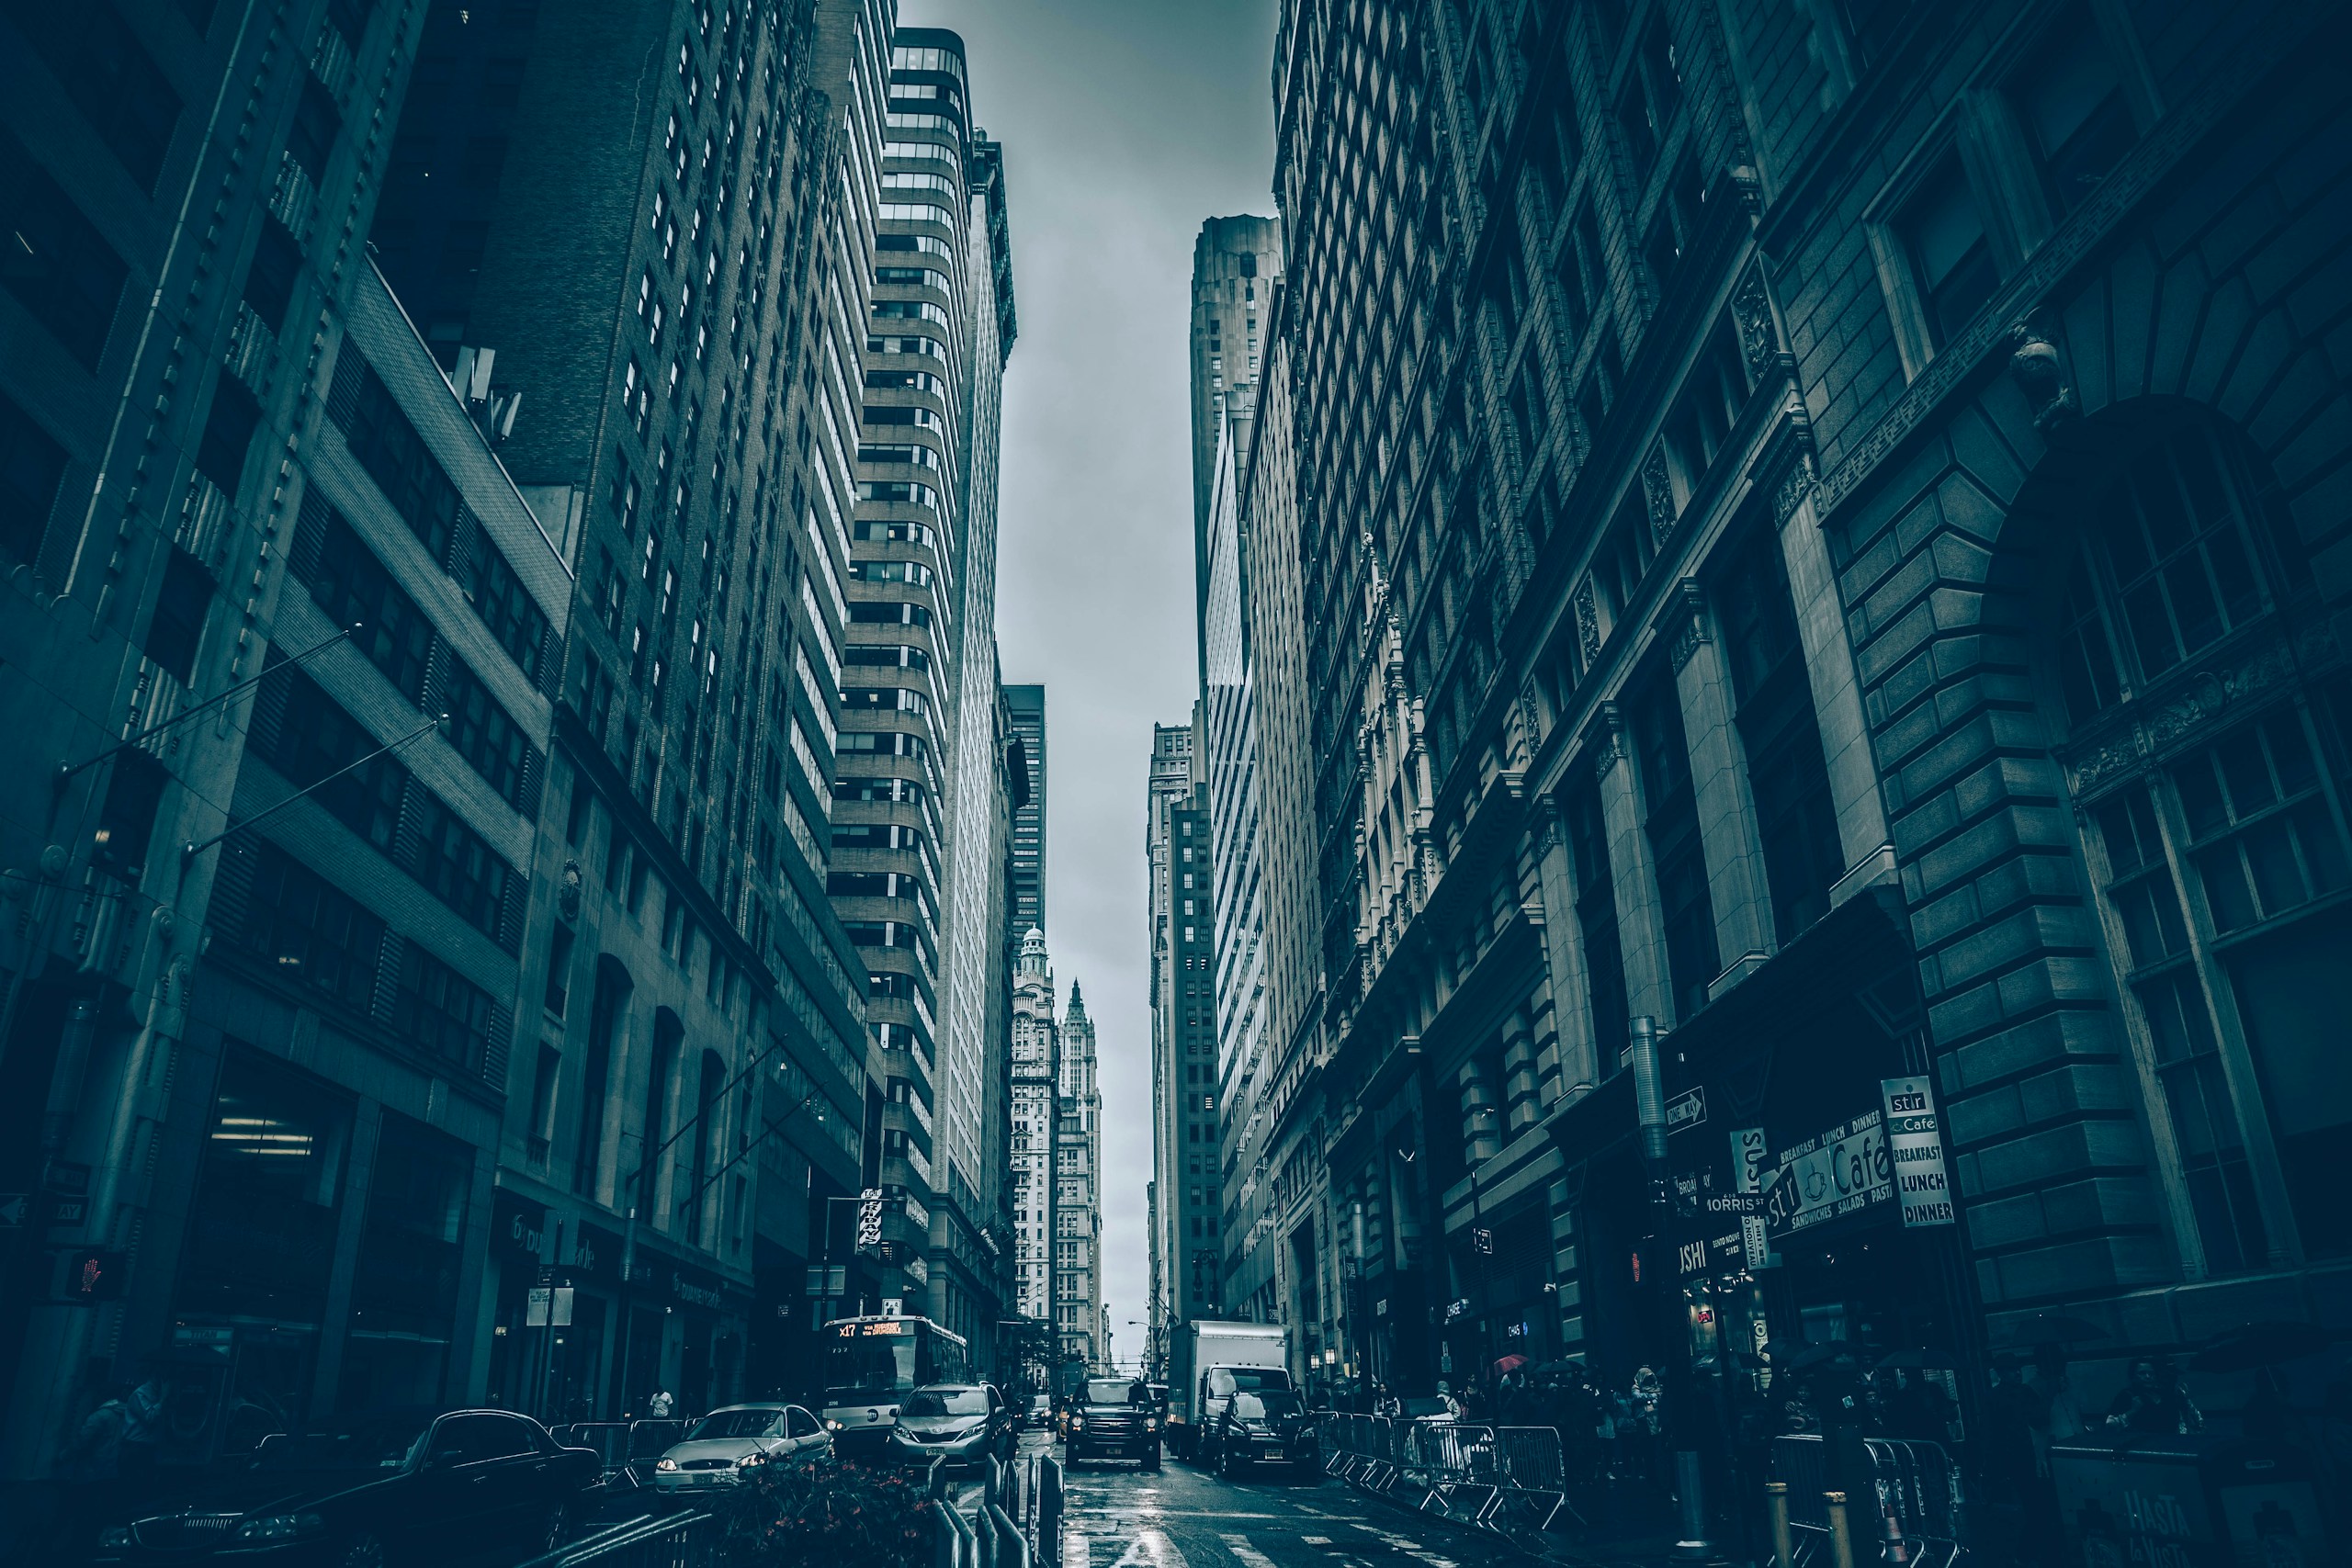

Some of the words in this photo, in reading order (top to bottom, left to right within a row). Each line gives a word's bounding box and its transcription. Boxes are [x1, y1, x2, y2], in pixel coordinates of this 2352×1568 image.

[1669, 1108, 1680, 1123] ONE
[1685, 1100, 1697, 1116] WAY
[1904, 1118, 1935, 1131] Café
[1781, 1139, 1815, 1163] BREAKFAST
[1822, 1126, 1845, 1145] LUNCH
[1852, 1110, 1881, 1134] DINNER
[1832, 1134, 1891, 1196] Café
[1894, 1145, 1940, 1163] BREAKFAST
[1901, 1173, 1945, 1192] LUNCH
[1792, 1205, 1833, 1229] SANDWICHES
[1838, 1193, 1865, 1215] SALADS
[1905, 1201, 1953, 1224] DINNER
[1746, 1227, 1756, 1267] NOUVEAU
[1447, 1302, 1461, 1317] CHASE
[191, 1329, 217, 1338] TITAN
[2124, 1490, 2190, 1536] HASTA
[2130, 1537, 2143, 1562] la
